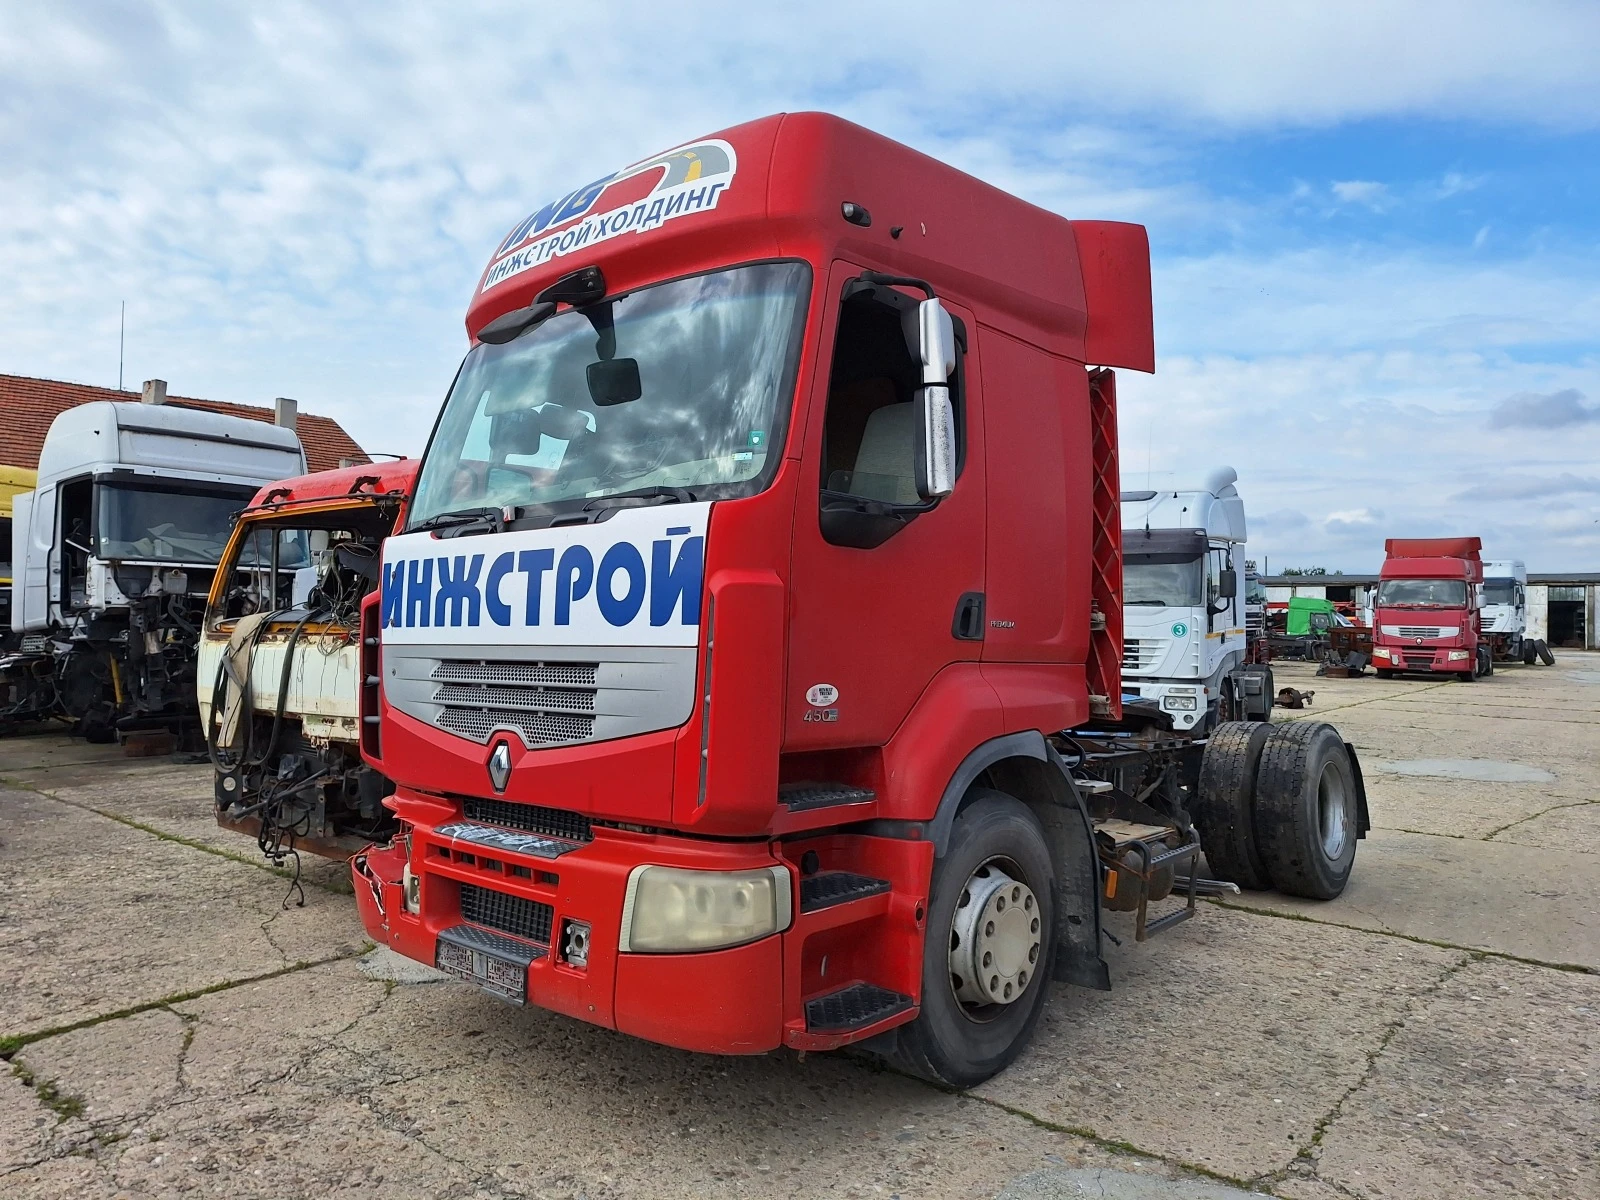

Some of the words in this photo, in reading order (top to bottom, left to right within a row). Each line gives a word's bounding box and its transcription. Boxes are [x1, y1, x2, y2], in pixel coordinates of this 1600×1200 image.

[485, 221, 592, 286] ИНЖСТРОЙ
[594, 182, 725, 239] ХОЛДИНГ
[382, 526, 704, 629] ИНЖСТРОЙ
[803, 709, 830, 722] 450
